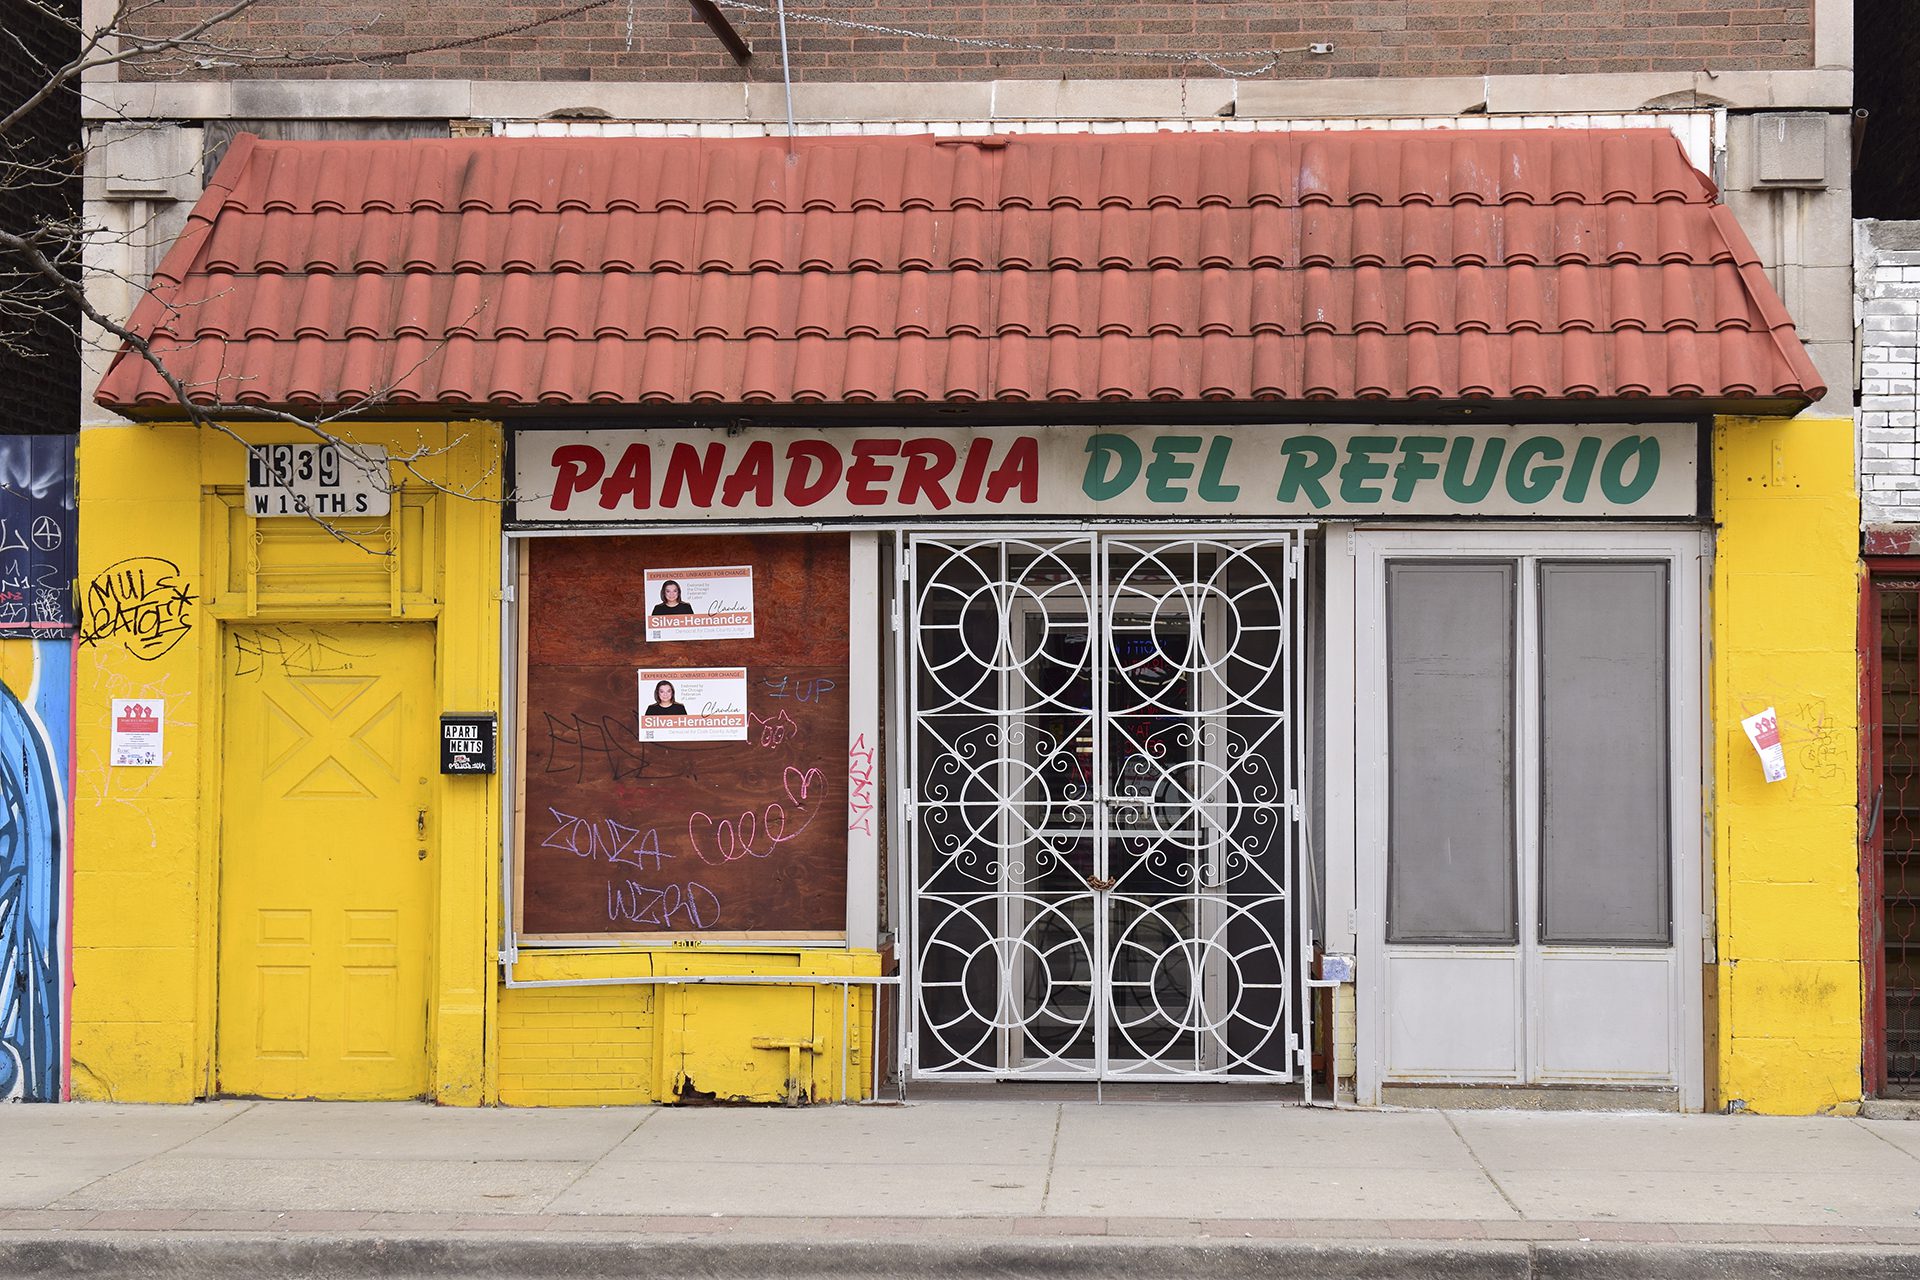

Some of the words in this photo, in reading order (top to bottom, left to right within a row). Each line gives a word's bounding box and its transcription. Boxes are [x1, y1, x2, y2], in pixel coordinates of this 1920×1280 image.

[250, 444, 339, 487] 1339
[550, 437, 1038, 511] PANADERIA
[1082, 433, 1240, 503] DEL
[1276, 435, 1660, 508] REFUGIO
[255, 494, 268, 513] W
[356, 493, 368, 513] S
[708, 600, 747, 617] Claudia
[651, 614, 749, 627] Silva-Hernandez
[701, 701, 741, 718] Claudia
[644, 716, 742, 728] Silva-Hernandez
[446, 726, 477, 738] APART
[450, 740, 482, 752] MENTS
